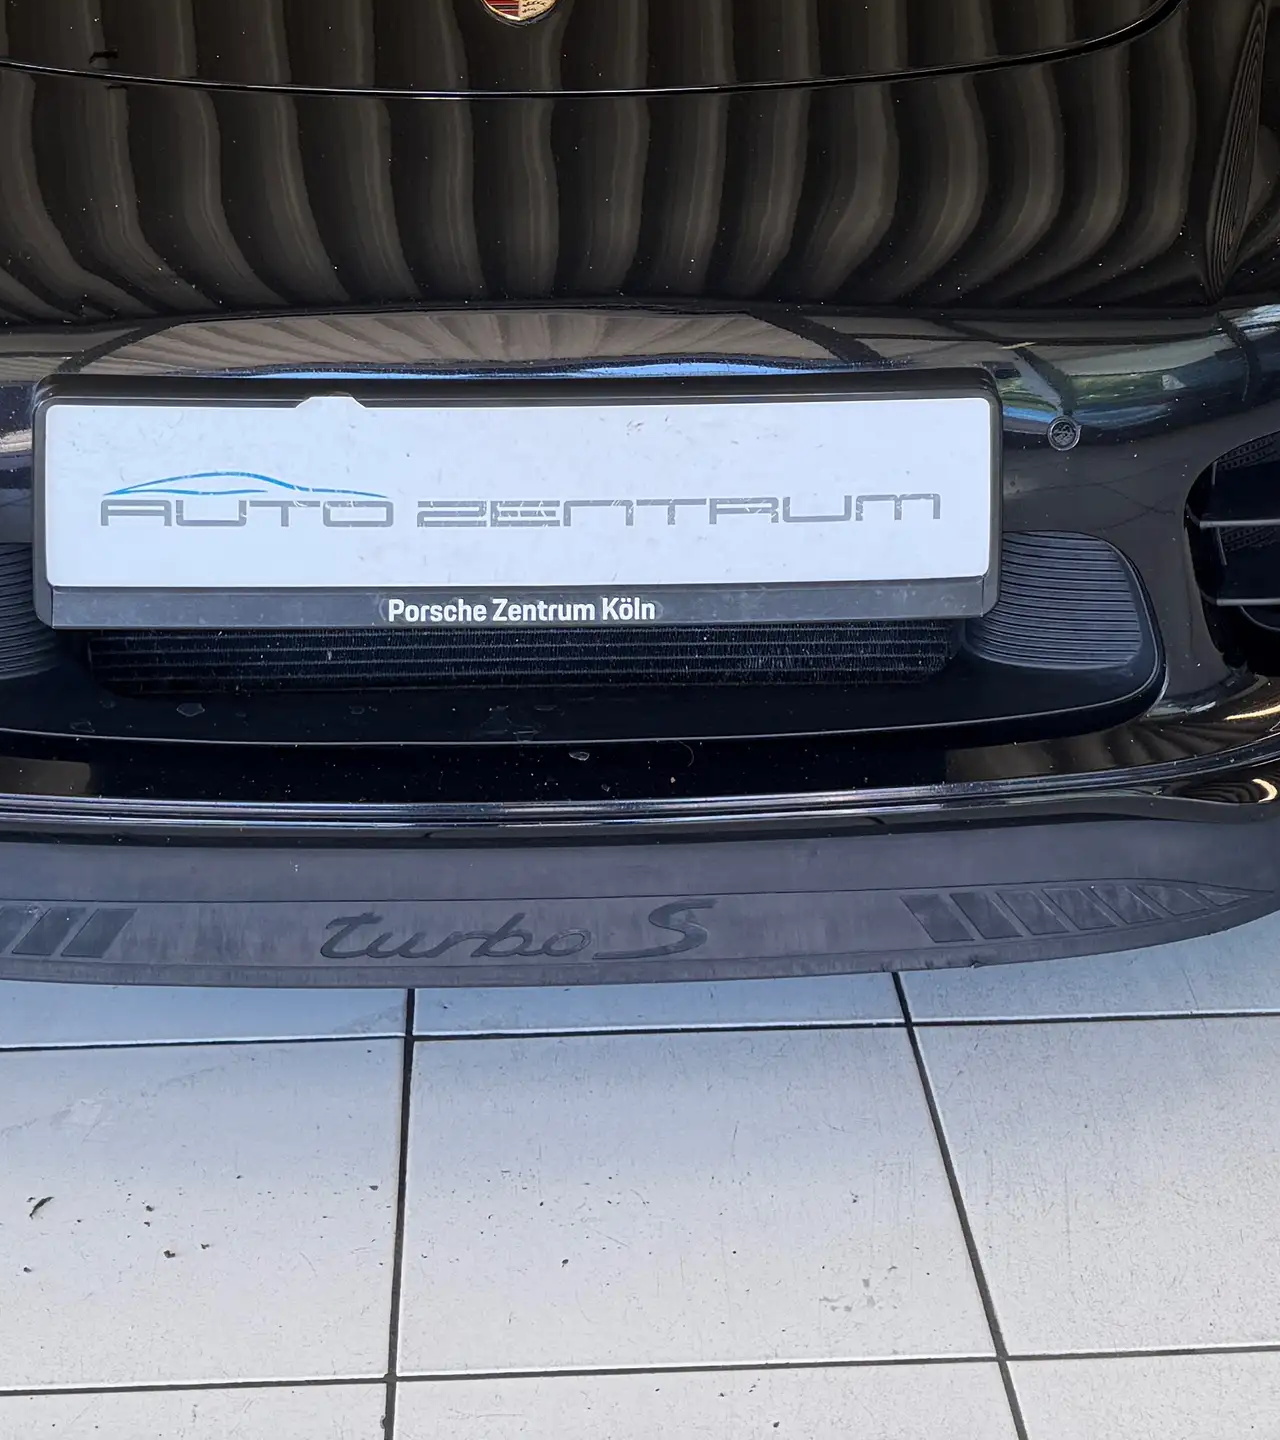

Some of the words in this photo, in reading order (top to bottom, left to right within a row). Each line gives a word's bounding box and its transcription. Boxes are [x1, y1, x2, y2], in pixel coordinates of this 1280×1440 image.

[100, 498, 394, 528] AUTO
[416, 492, 941, 528] ZENTRUM
[388, 598, 487, 623] Porsche
[491, 598, 596, 622] Zentrum
[601, 596, 656, 621] Köln
[319, 911, 593, 959] turbo
[592, 897, 719, 961] S
